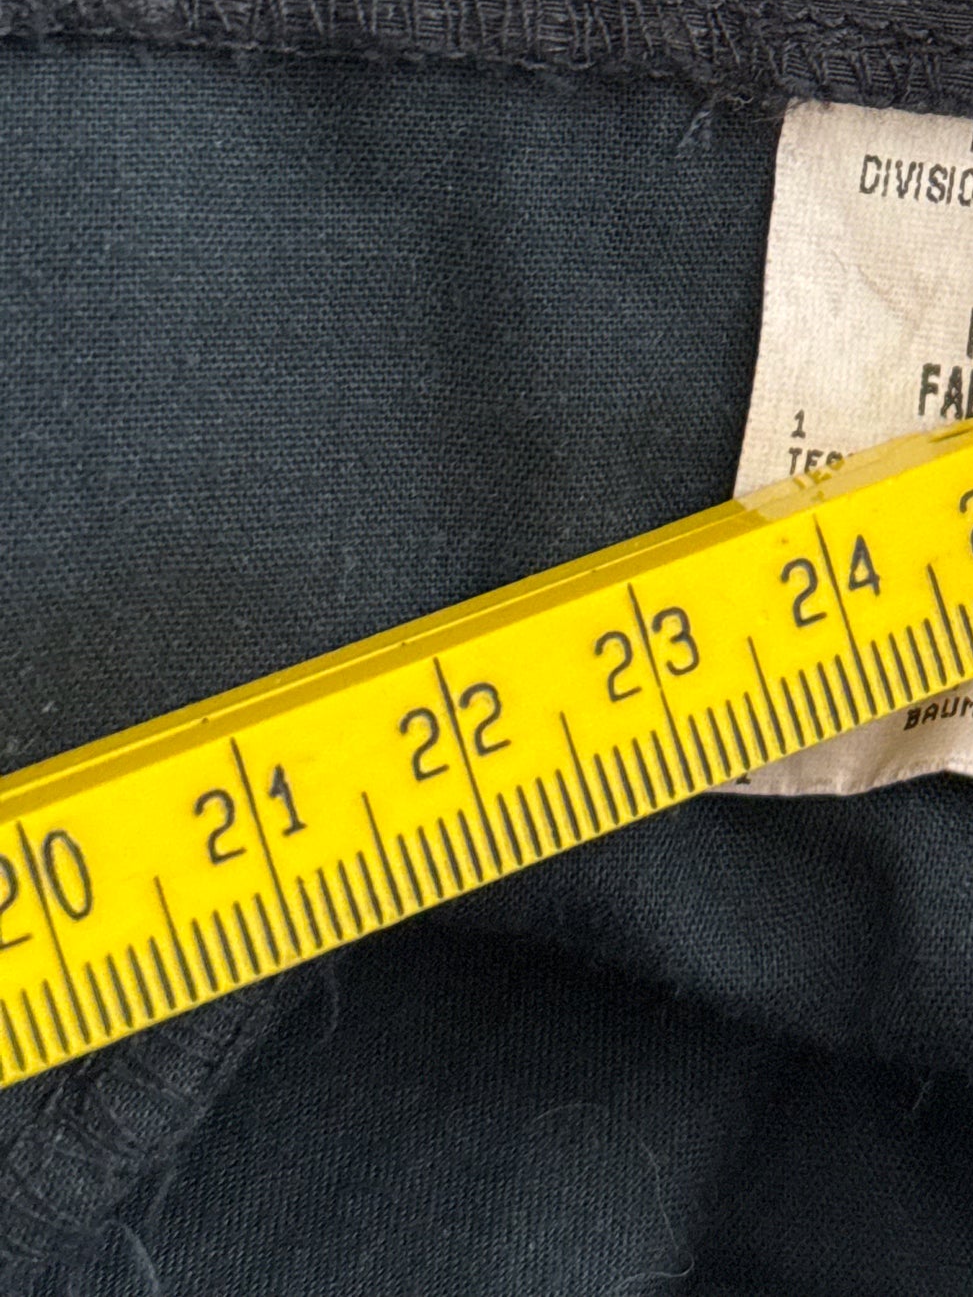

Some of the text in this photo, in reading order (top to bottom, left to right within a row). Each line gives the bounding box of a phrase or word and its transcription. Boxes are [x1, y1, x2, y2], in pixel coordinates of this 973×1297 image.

[194, 764, 306, 865] 21
[399, 682, 512, 782] 22
[594, 606, 700, 703] 23
[780, 534, 881, 628] 24
